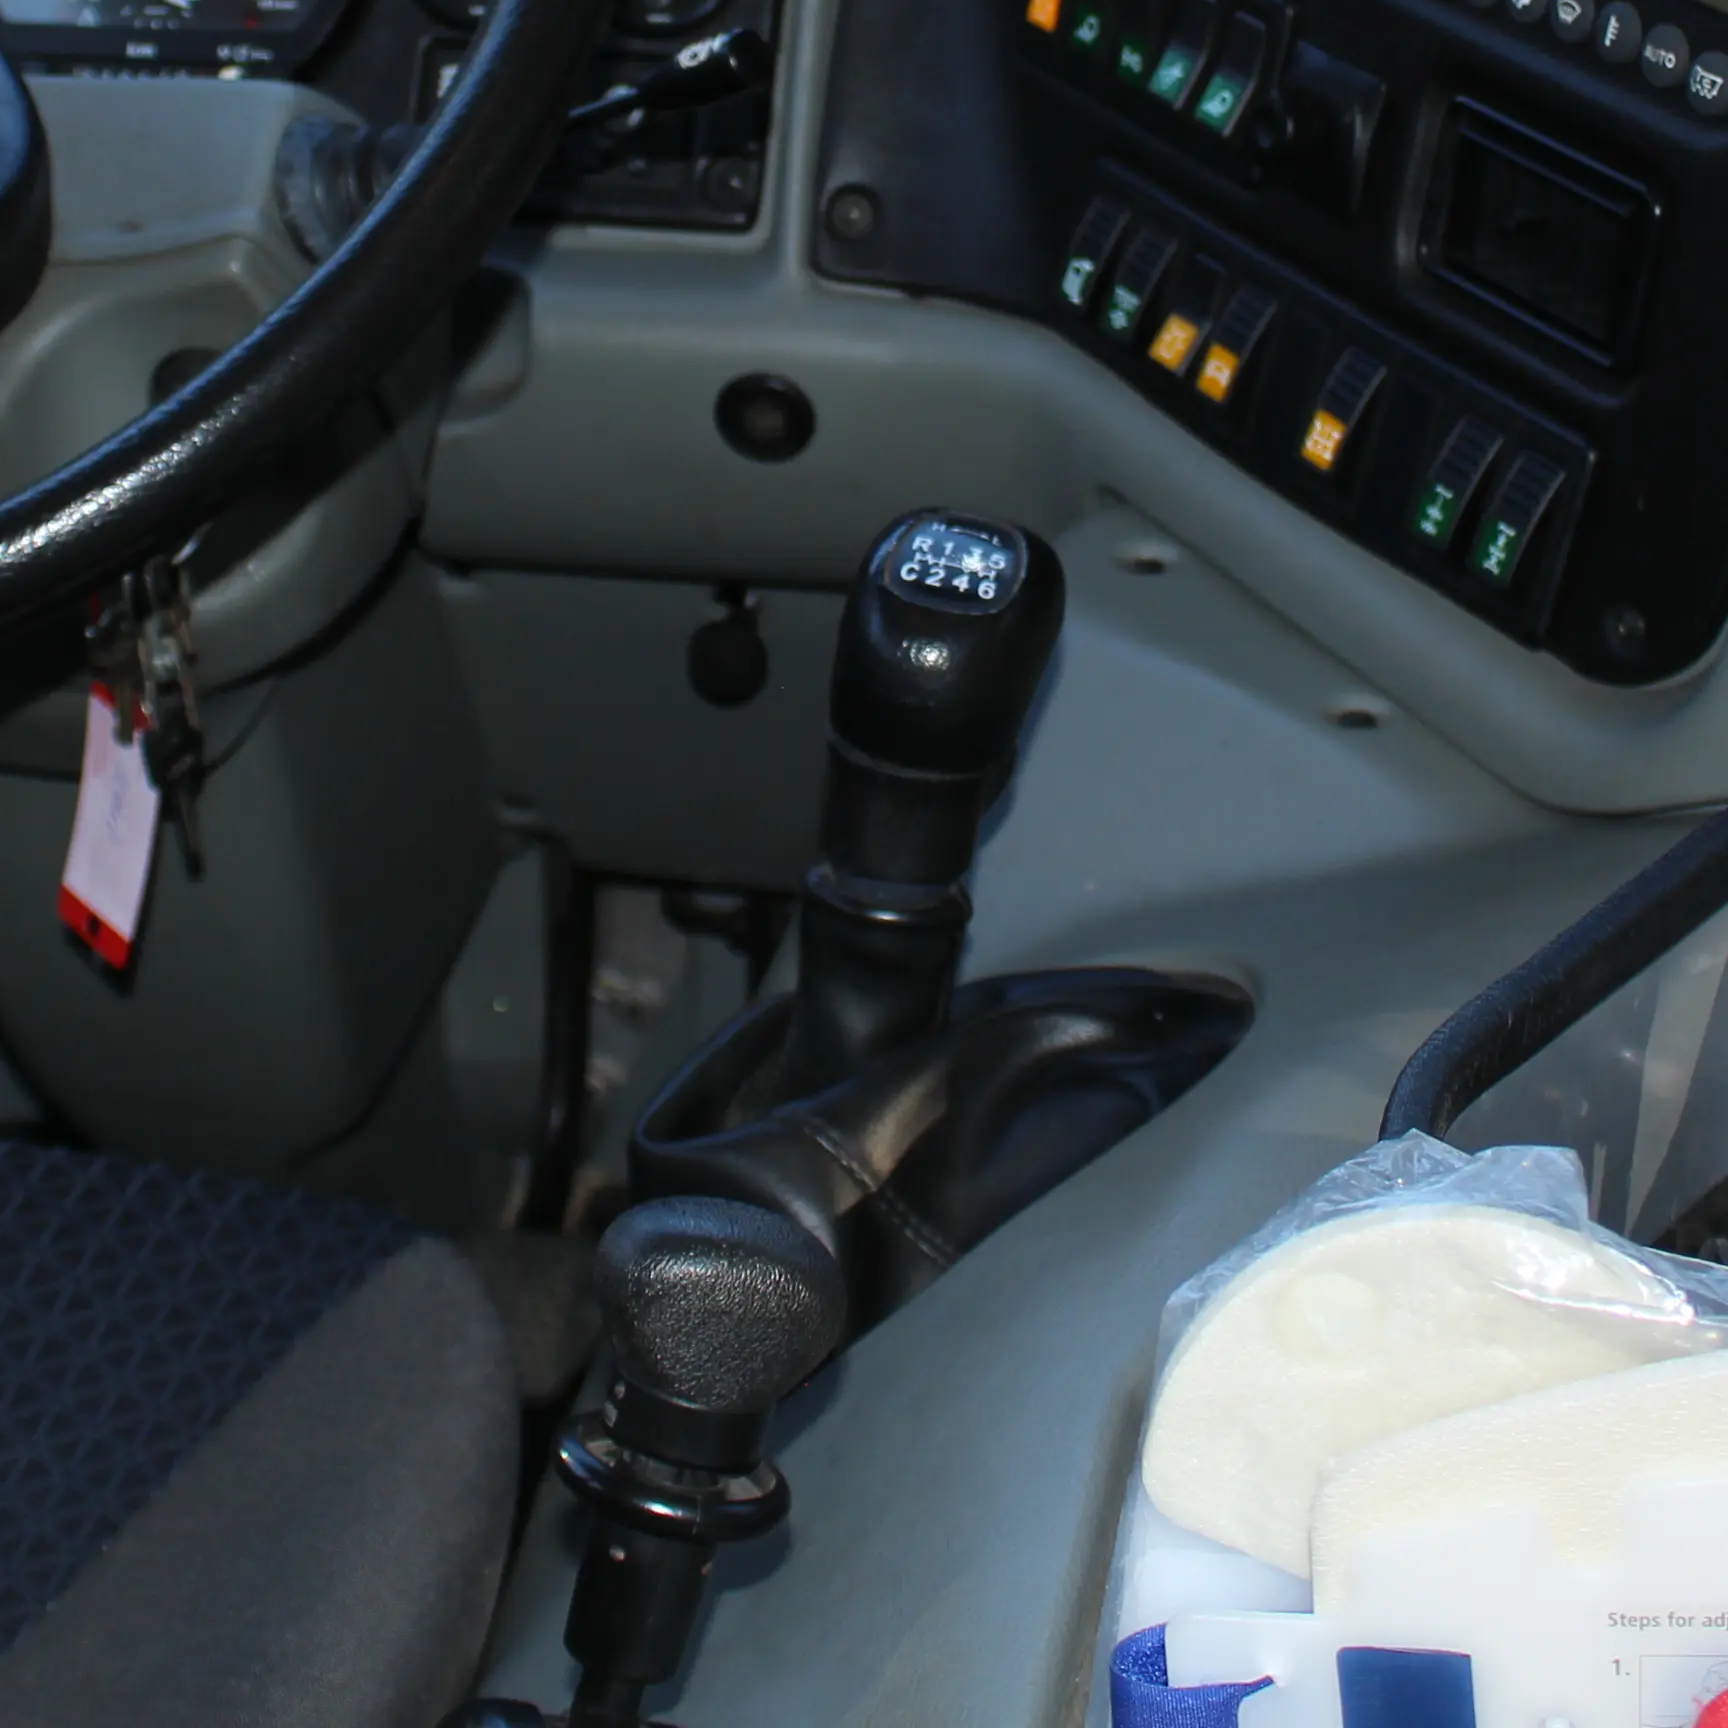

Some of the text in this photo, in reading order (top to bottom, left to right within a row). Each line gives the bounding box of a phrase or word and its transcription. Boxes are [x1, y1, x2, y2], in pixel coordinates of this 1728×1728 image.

[1643, 44, 1676, 69] AUTO
[912, 535, 933, 552] R
[988, 553, 1006, 570] 5
[899, 561, 997, 600] C 2 4 6
[1607, 1612, 1661, 1630] Steps
[1667, 1611, 1695, 1628] for
[1611, 1659, 1631, 1677] 1.
